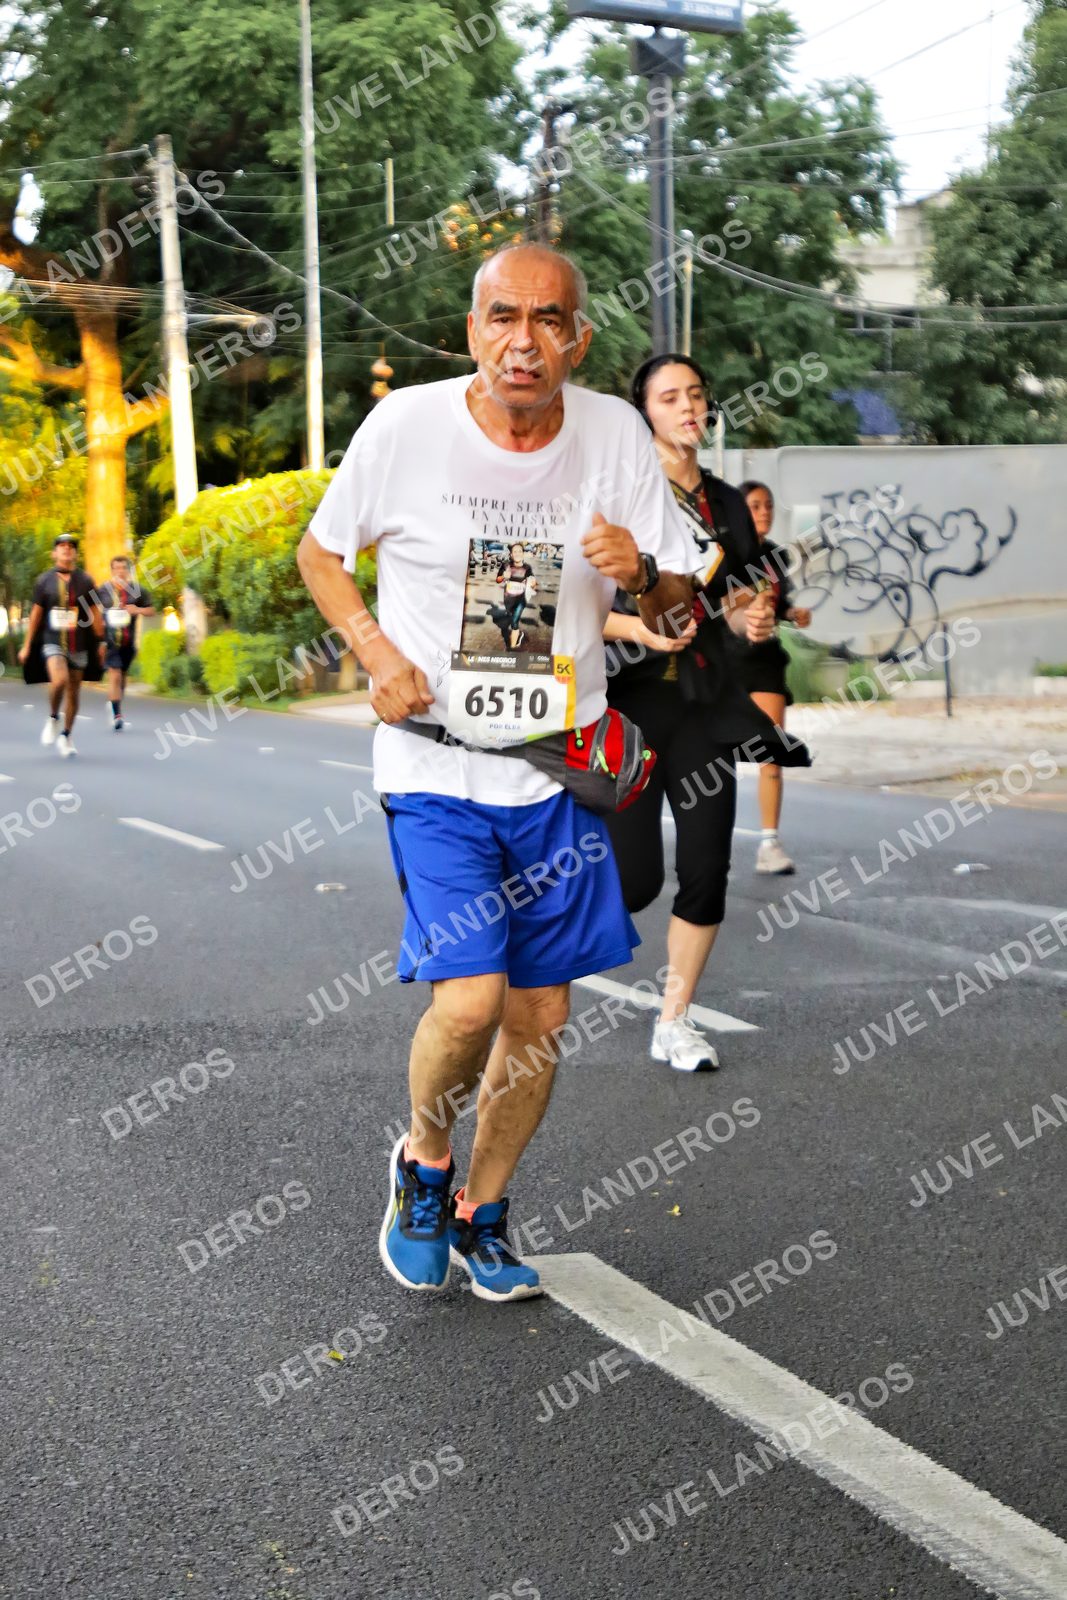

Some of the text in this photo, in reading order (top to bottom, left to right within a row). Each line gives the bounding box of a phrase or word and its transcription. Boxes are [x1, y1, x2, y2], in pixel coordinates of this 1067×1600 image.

[441, 493, 508, 511] SIEMPRE
[557, 663, 570, 675] 5K
[465, 684, 549, 720] 6510
